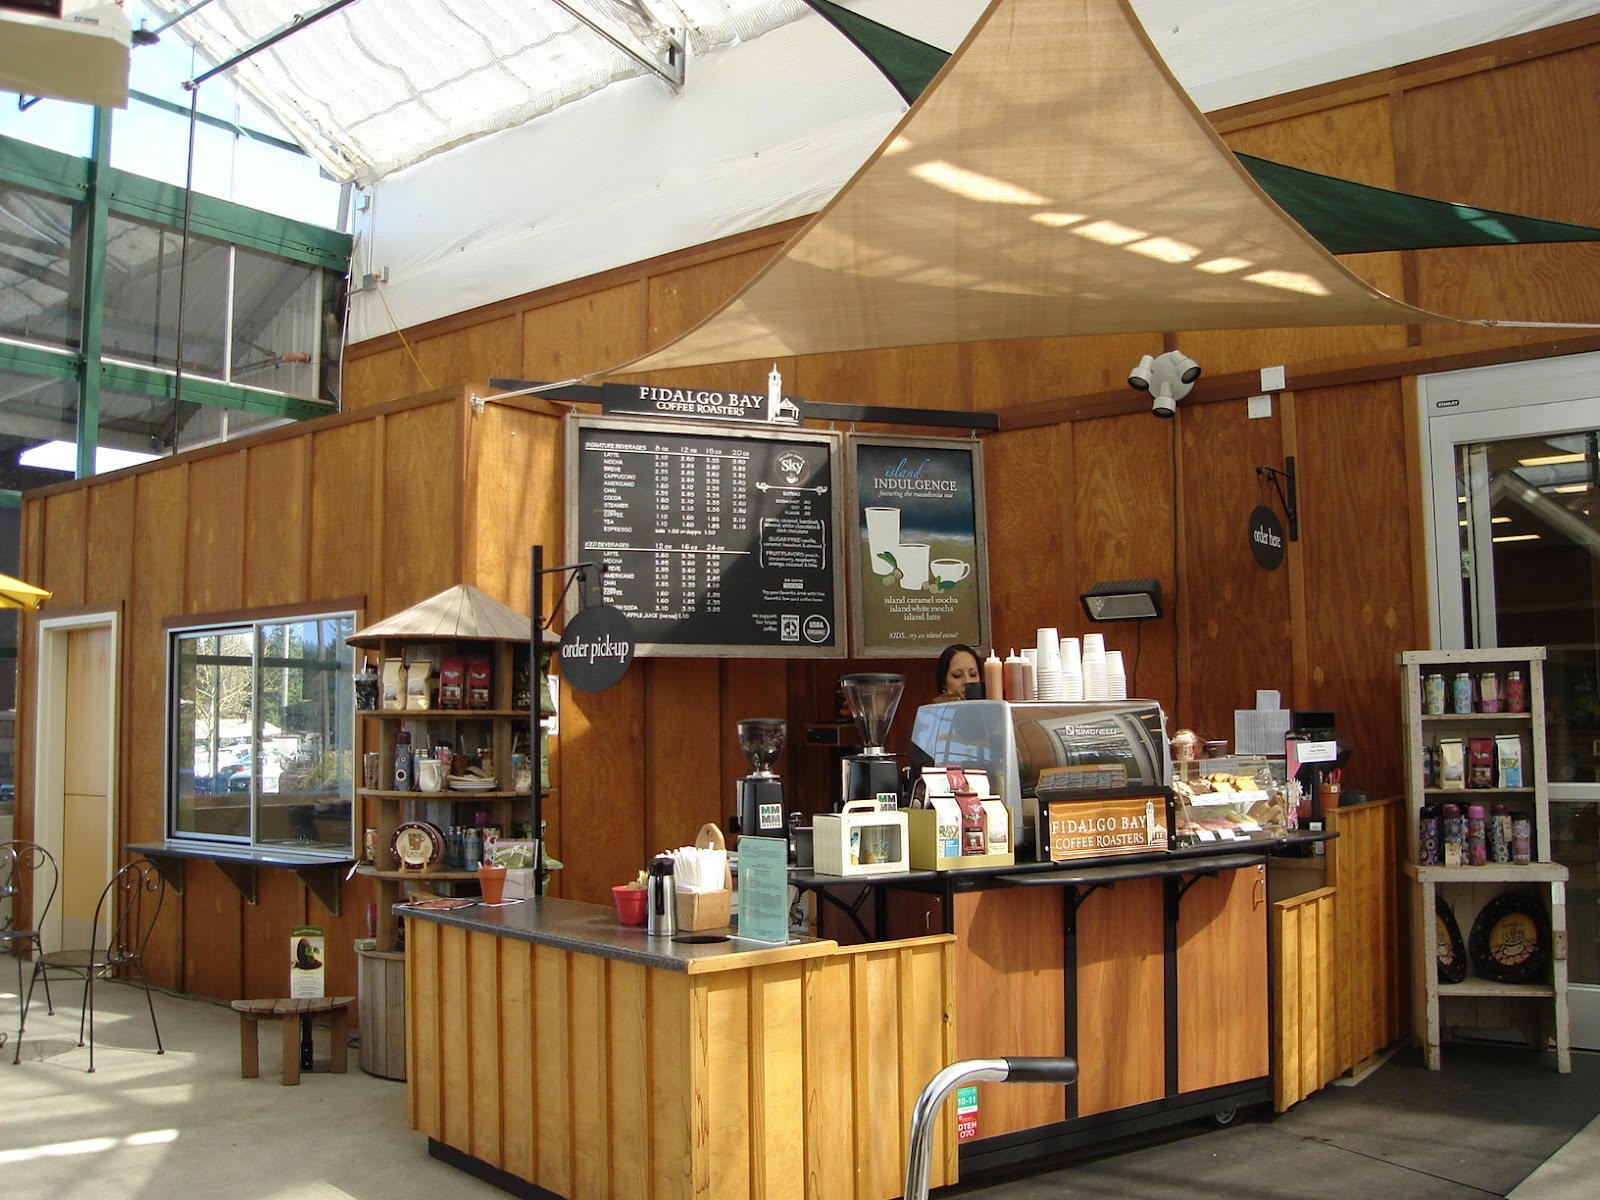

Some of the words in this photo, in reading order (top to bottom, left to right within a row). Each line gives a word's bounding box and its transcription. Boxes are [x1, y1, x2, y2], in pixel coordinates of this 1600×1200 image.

[639, 386, 724, 406] FIDALGO
[728, 393, 764, 409] BAY
[656, 401, 696, 412] COFFEE
[696, 403, 745, 417] ROASTERS
[615, 443, 647, 451] BEVERAGES
[781, 459, 804, 475] Sky
[885, 457, 930, 479] island
[874, 478, 958, 491] INDULGENCE
[878, 489, 903, 498] featuring
[1253, 525, 1269, 545] order
[1268, 527, 1281, 548] here
[884, 595, 906, 604] island
[906, 595, 934, 604] caramel
[935, 595, 959, 604] mocha
[889, 604, 911, 612] island
[911, 604, 930, 612] white
[930, 604, 954, 612] mocha
[904, 612, 925, 621] island
[926, 613, 941, 621] latte
[562, 635, 589, 658] order
[589, 634, 629, 665] pick-up
[1075, 728, 1117, 736] SIMONELLI
[1051, 817, 1116, 835] FIDALGO
[1121, 815, 1147, 830] BAY
[1055, 836, 1094, 850] COFFEE
[1096, 832, 1144, 848] ROASTERS
